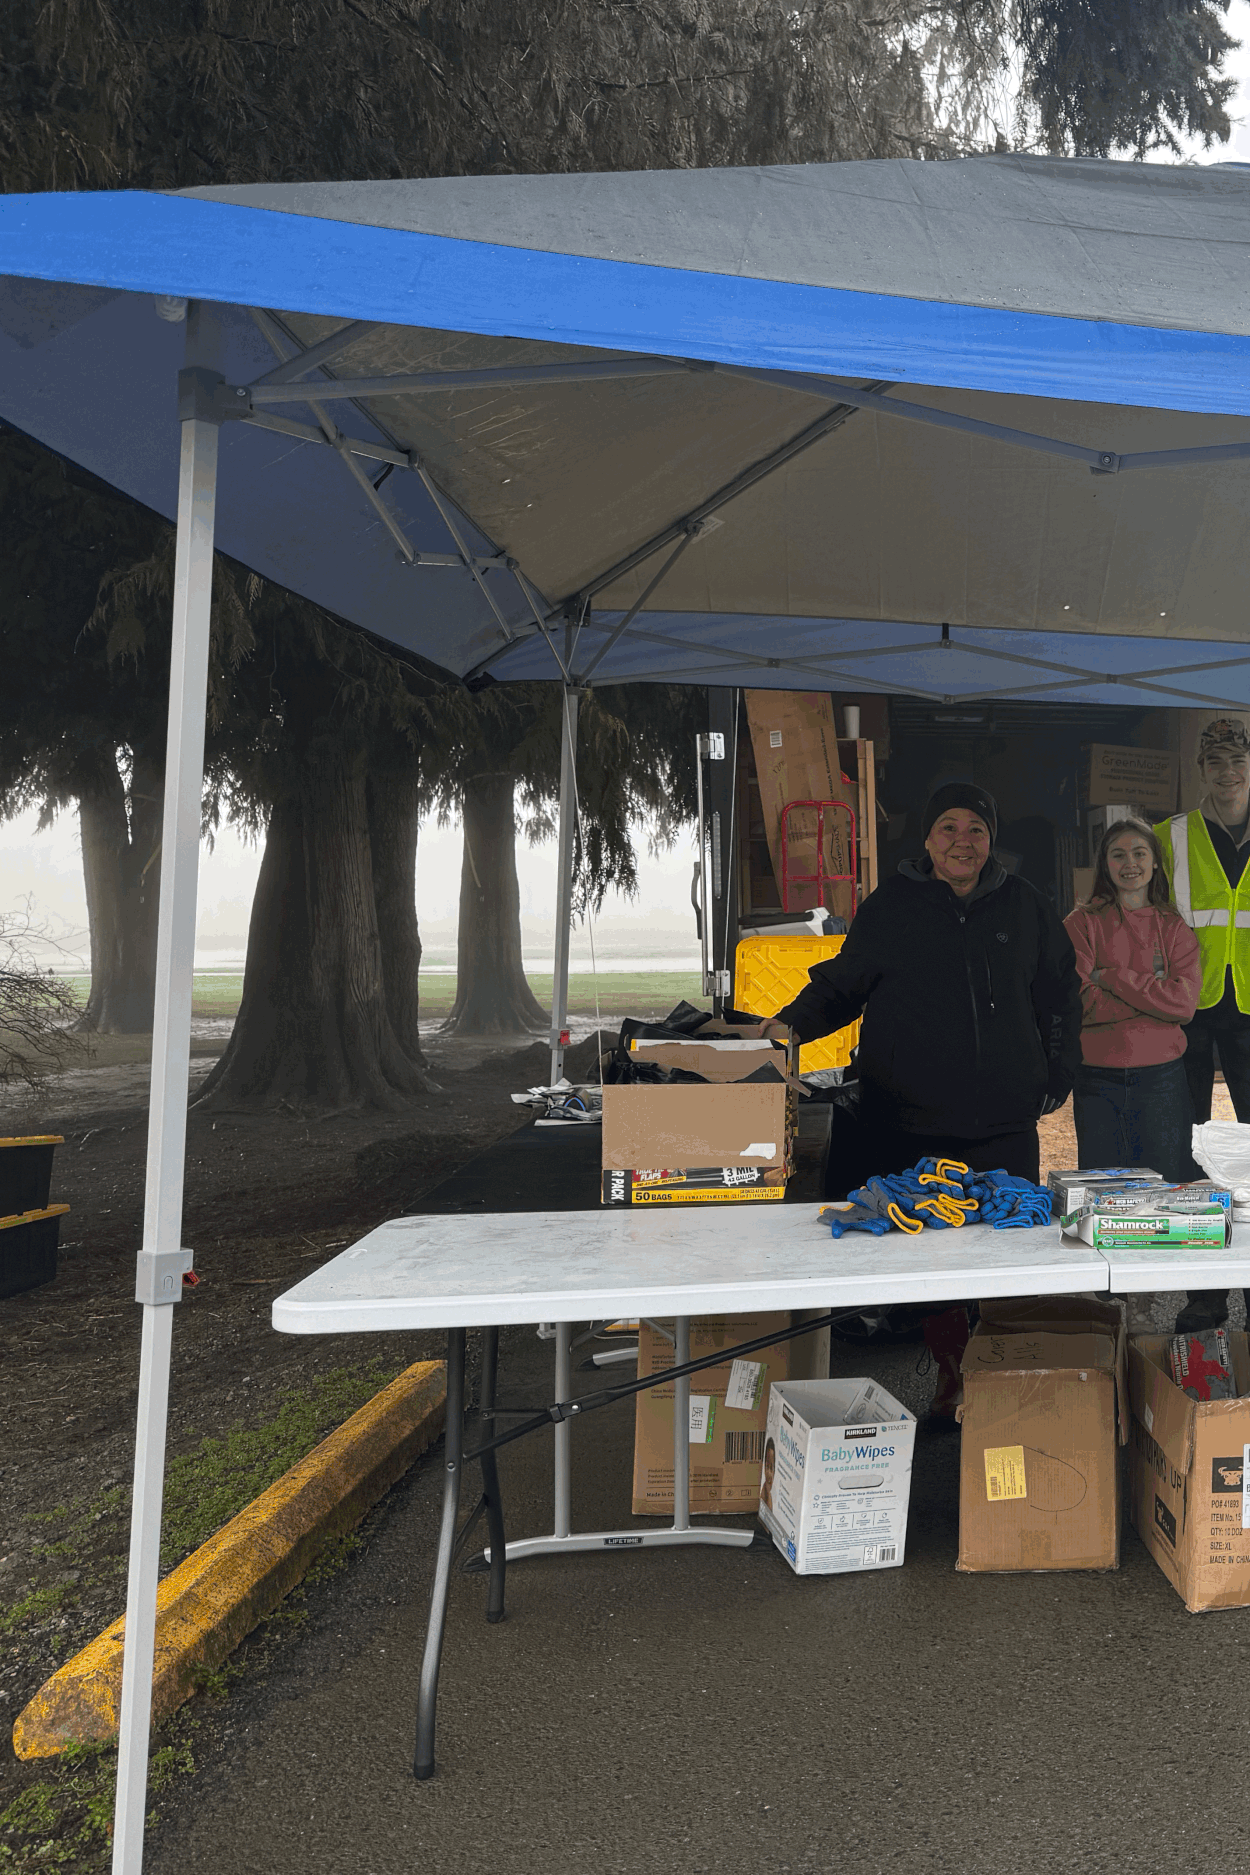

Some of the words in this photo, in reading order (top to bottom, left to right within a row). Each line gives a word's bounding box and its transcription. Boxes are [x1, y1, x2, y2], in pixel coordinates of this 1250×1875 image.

[640, 1172, 663, 1181] FLAPS
[727, 1168, 734, 1177] 3
[736, 1167, 755, 1176] MIL
[611, 1179, 625, 1201] PACK
[635, 1191, 650, 1201] 50
[651, 1193, 673, 1201] BAGS
[1100, 1219, 1164, 1230] Shamrock
[1178, 1334, 1190, 1377] NITRISHIELD
[845, 1428, 876, 1437] KIRKLAND
[824, 1464, 870, 1473] FRAGRANCE
[871, 1462, 890, 1470] FREE
[1170, 1466, 1182, 1494] UP
[1211, 1499, 1223, 1509] PO#
[1210, 1513, 1224, 1522] ITEM
[1210, 1527, 1223, 1537] QTY:
[1209, 1555, 1226, 1565] MADE
[1228, 1555, 1234, 1564] IN
